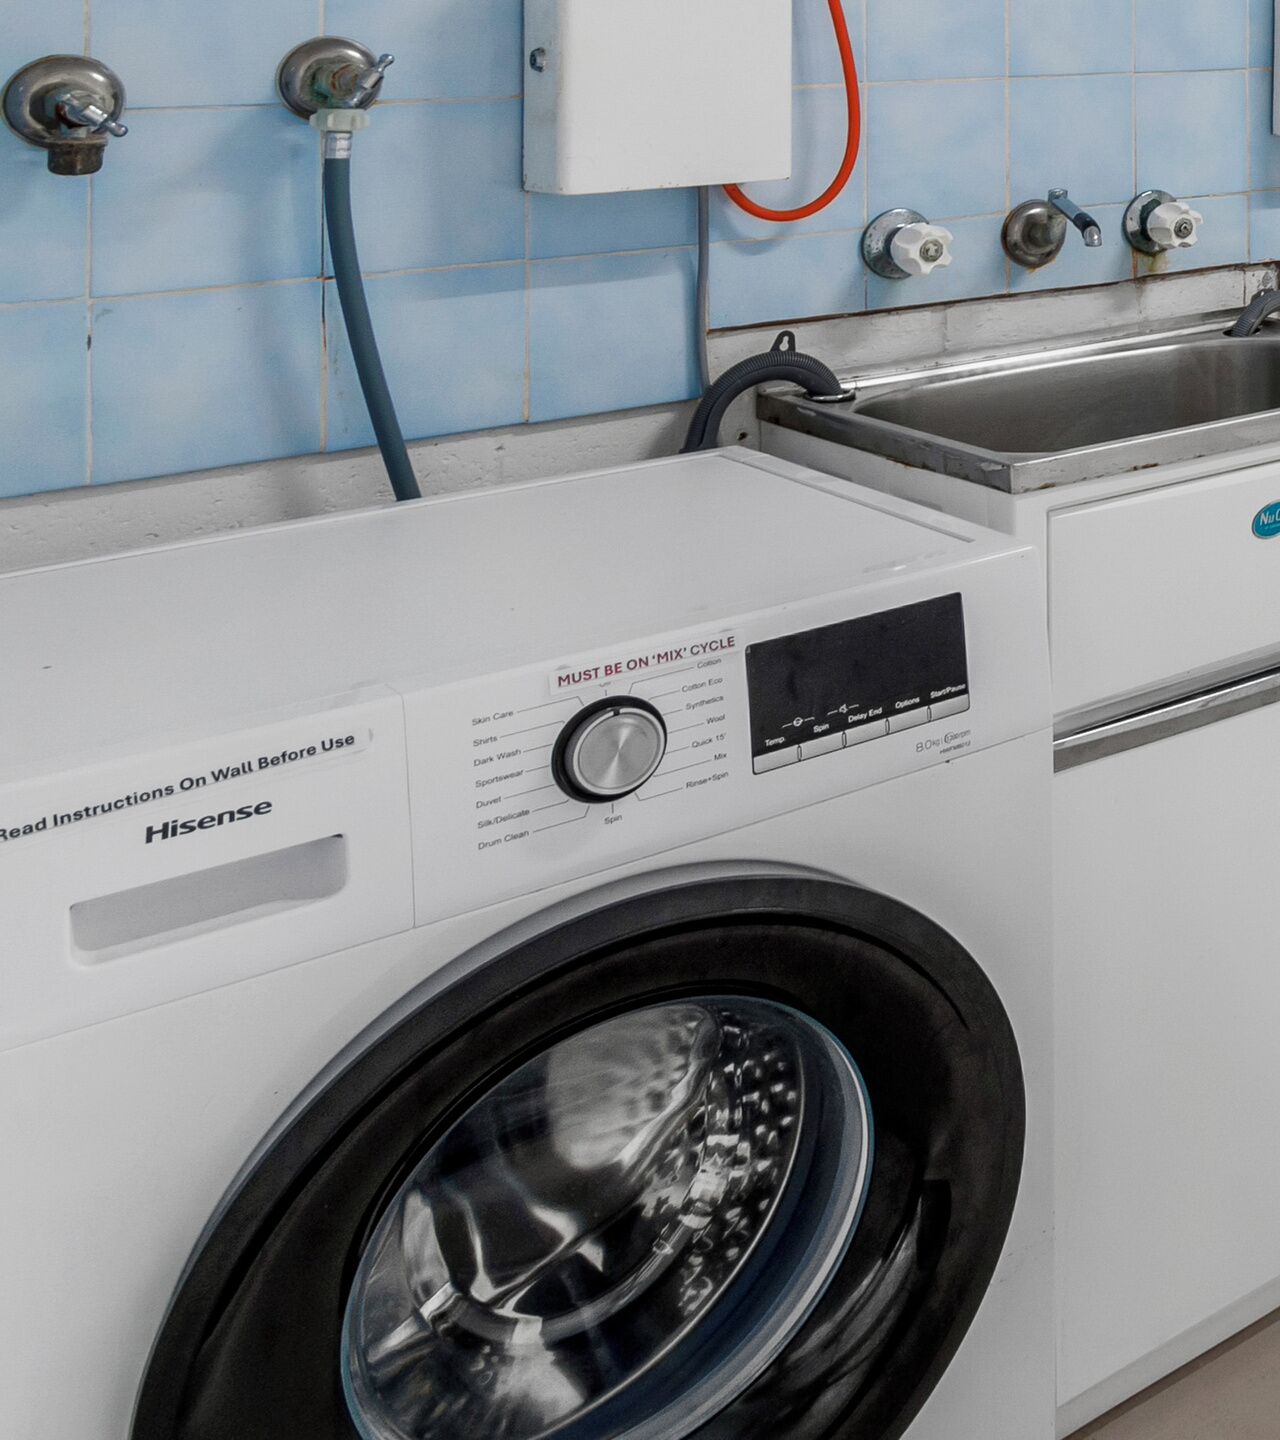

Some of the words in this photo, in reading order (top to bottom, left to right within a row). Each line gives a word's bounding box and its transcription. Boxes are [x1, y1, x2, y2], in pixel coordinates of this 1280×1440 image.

[557, 667, 600, 687] MUST
[604, 661, 623, 676] BE
[626, 656, 649, 671] ON
[690, 636, 736, 656] CYCLE
[681, 681, 707, 693] Cotton
[708, 677, 723, 686] Eco
[930, 683, 966, 699] Start/Pause
[685, 695, 724, 711] Synthetics
[895, 696, 920, 709] Options
[471, 715, 491, 726] Skin
[493, 710, 514, 720] Care
[706, 714, 725, 725] Wool
[848, 712, 868, 723] Delay
[869, 707, 883, 717] End
[813, 723, 830, 733] Spin
[473, 735, 498, 747] Shirts
[691, 737, 713, 748] Quick
[473, 755, 495, 767] Dark
[497, 749, 521, 761] Wash
[713, 752, 727, 761] Mix
[475, 769, 524, 788] Sportswear
[685, 771, 729, 789] Rinse+Spin
[0, 817, 47, 842] Read
[53, 784, 175, 828] Instructions
[180, 774, 207, 792] On
[211, 761, 254, 783] Wall
[257, 744, 317, 770] Before
[321, 734, 355, 752] Use
[475, 796, 502, 809] Duvet
[144, 800, 273, 844] Hisense
[477, 809, 531, 829] Silk/Delicate
[604, 814, 623, 826] Spin
[478, 839, 502, 850] Drum
[504, 830, 530, 843] Clean
